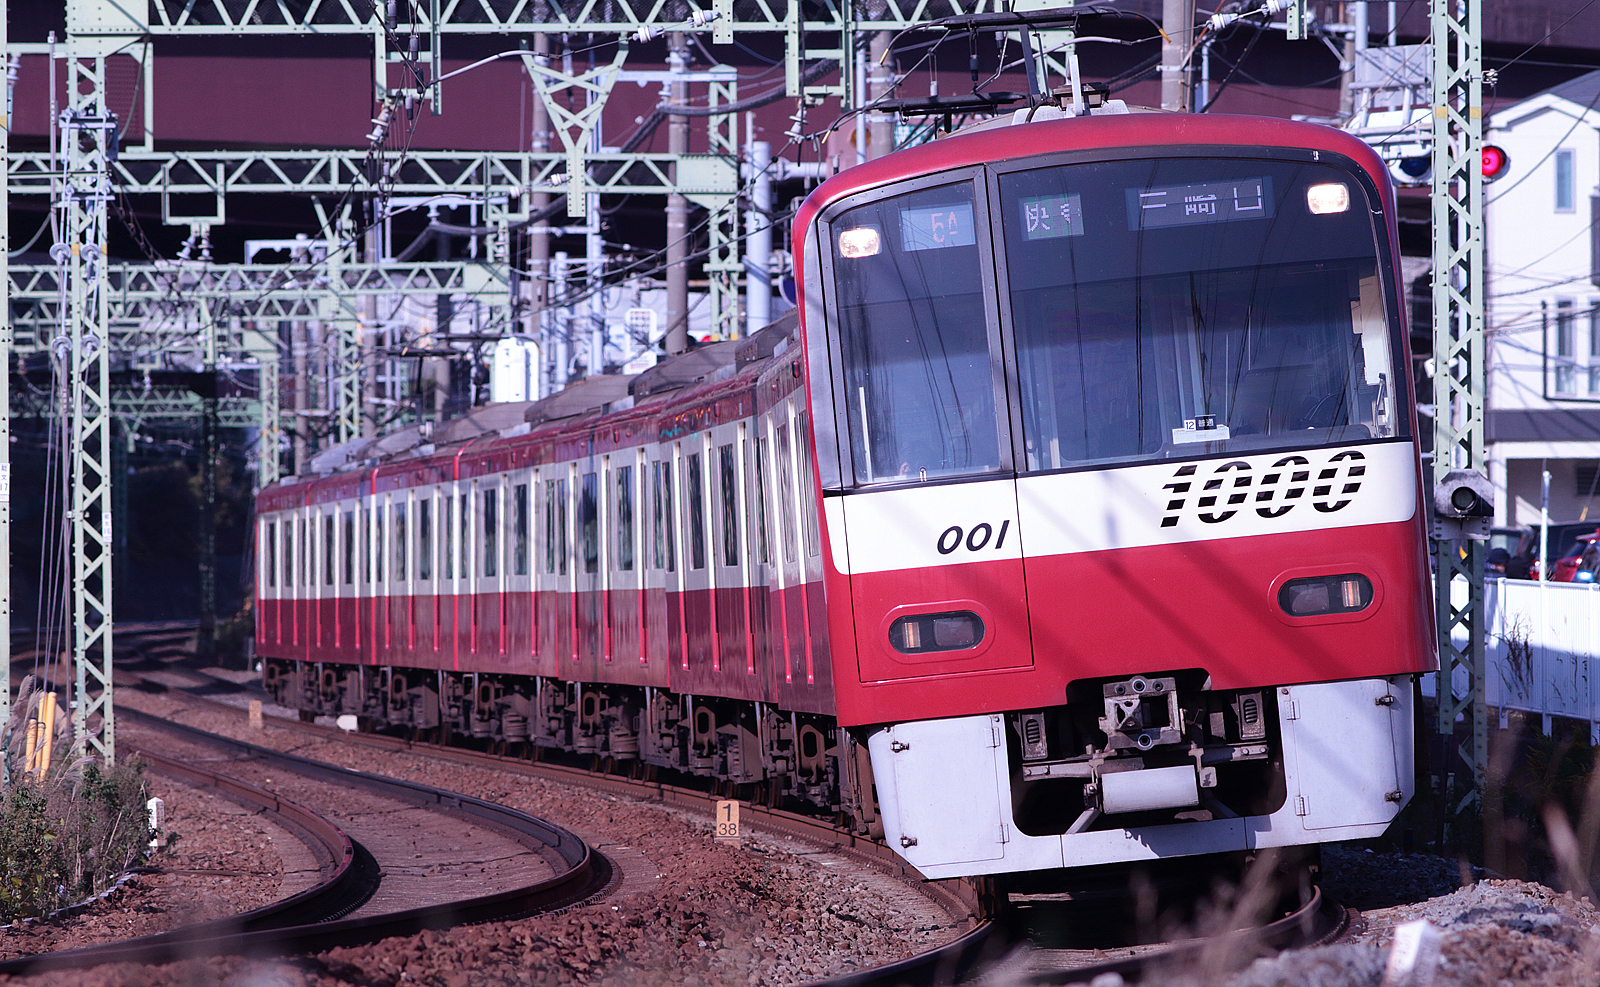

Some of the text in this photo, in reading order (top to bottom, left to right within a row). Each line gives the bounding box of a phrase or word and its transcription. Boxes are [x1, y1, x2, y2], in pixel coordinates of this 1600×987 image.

[1185, 421, 1195, 430] 12
[1160, 450, 1367, 528] 1000
[937, 520, 1010, 555] 001
[722, 803, 731, 821] 1
[719, 823, 737, 835] 38
